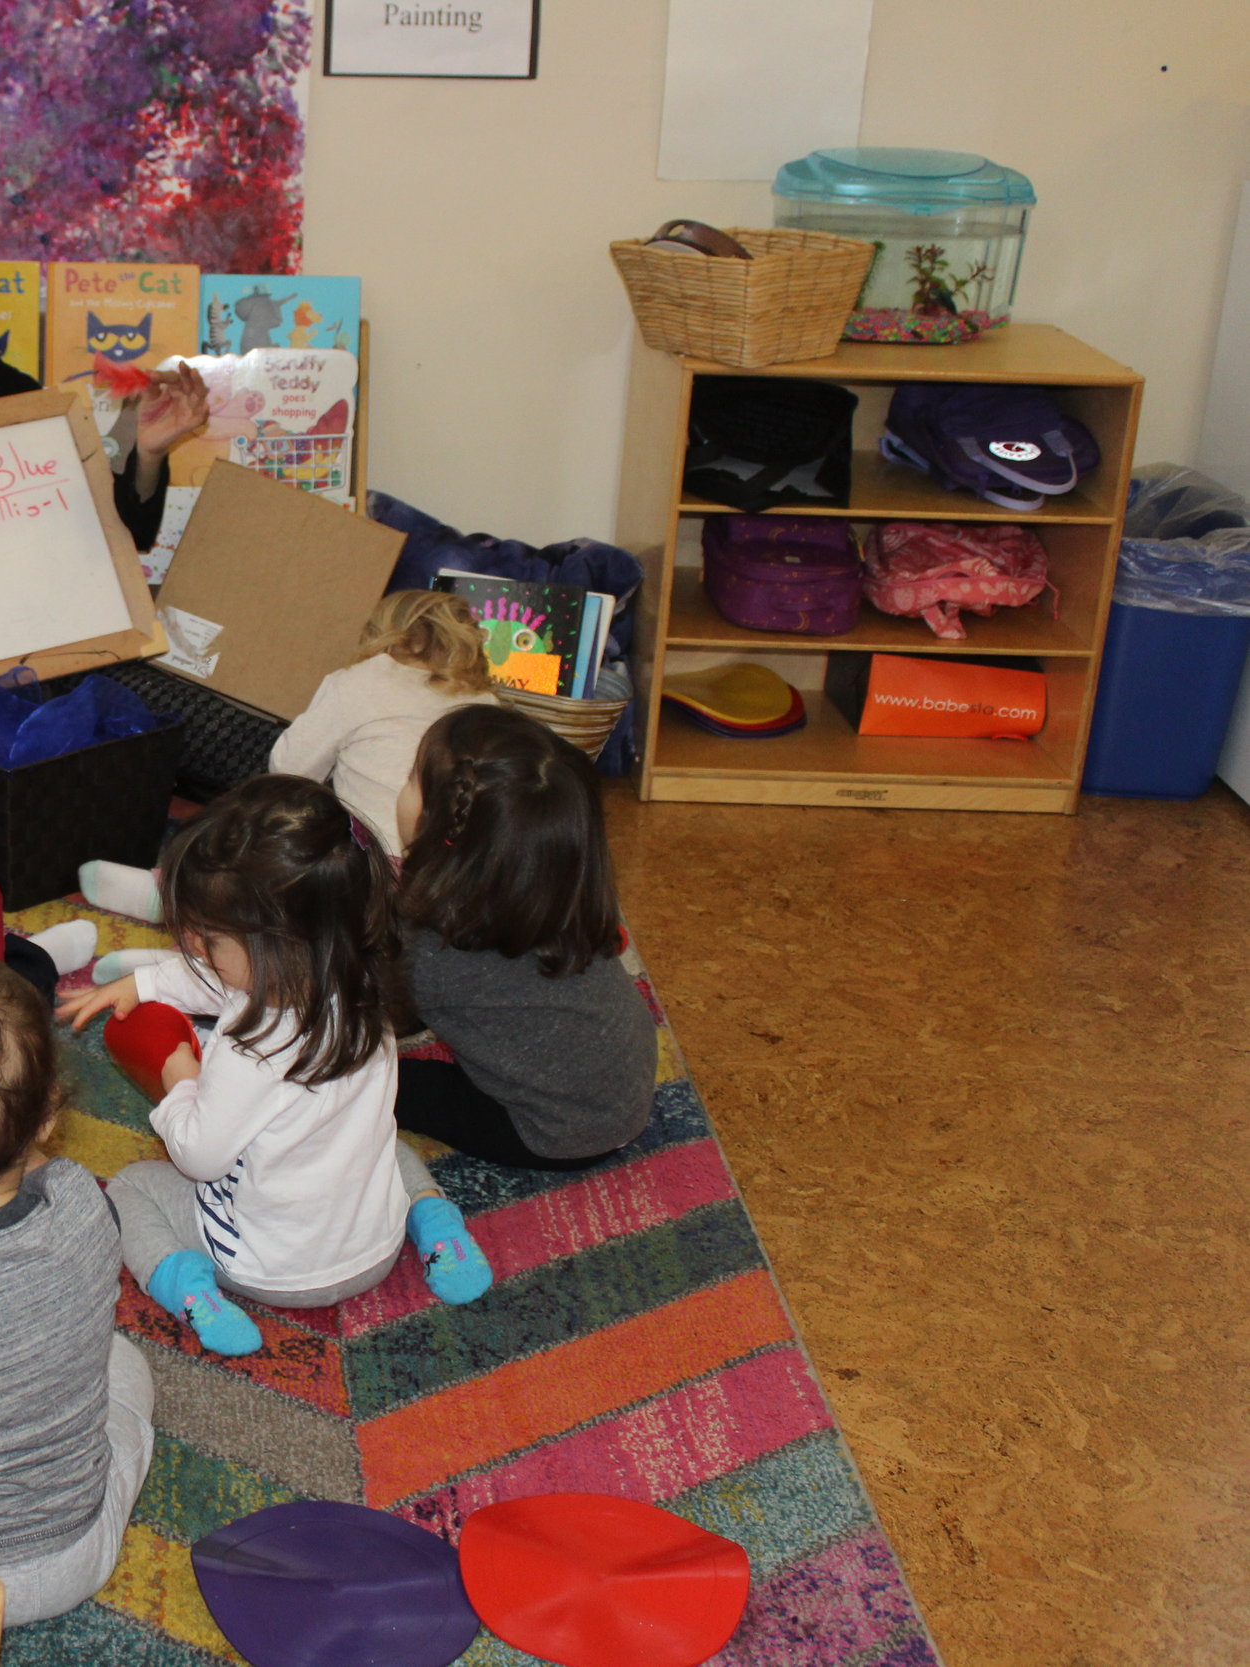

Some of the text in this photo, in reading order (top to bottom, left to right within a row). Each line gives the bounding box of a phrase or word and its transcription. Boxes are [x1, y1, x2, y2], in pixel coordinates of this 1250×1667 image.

[384, 3, 483, 33] Painting
[65, 268, 117, 294] Pete
[138, 271, 183, 294] Cat
[270, 375, 320, 393] Teddy
[282, 394, 306, 404] goes
[271, 407, 317, 420] shopping
[874, 693, 1037, 720] www.babesta.com
